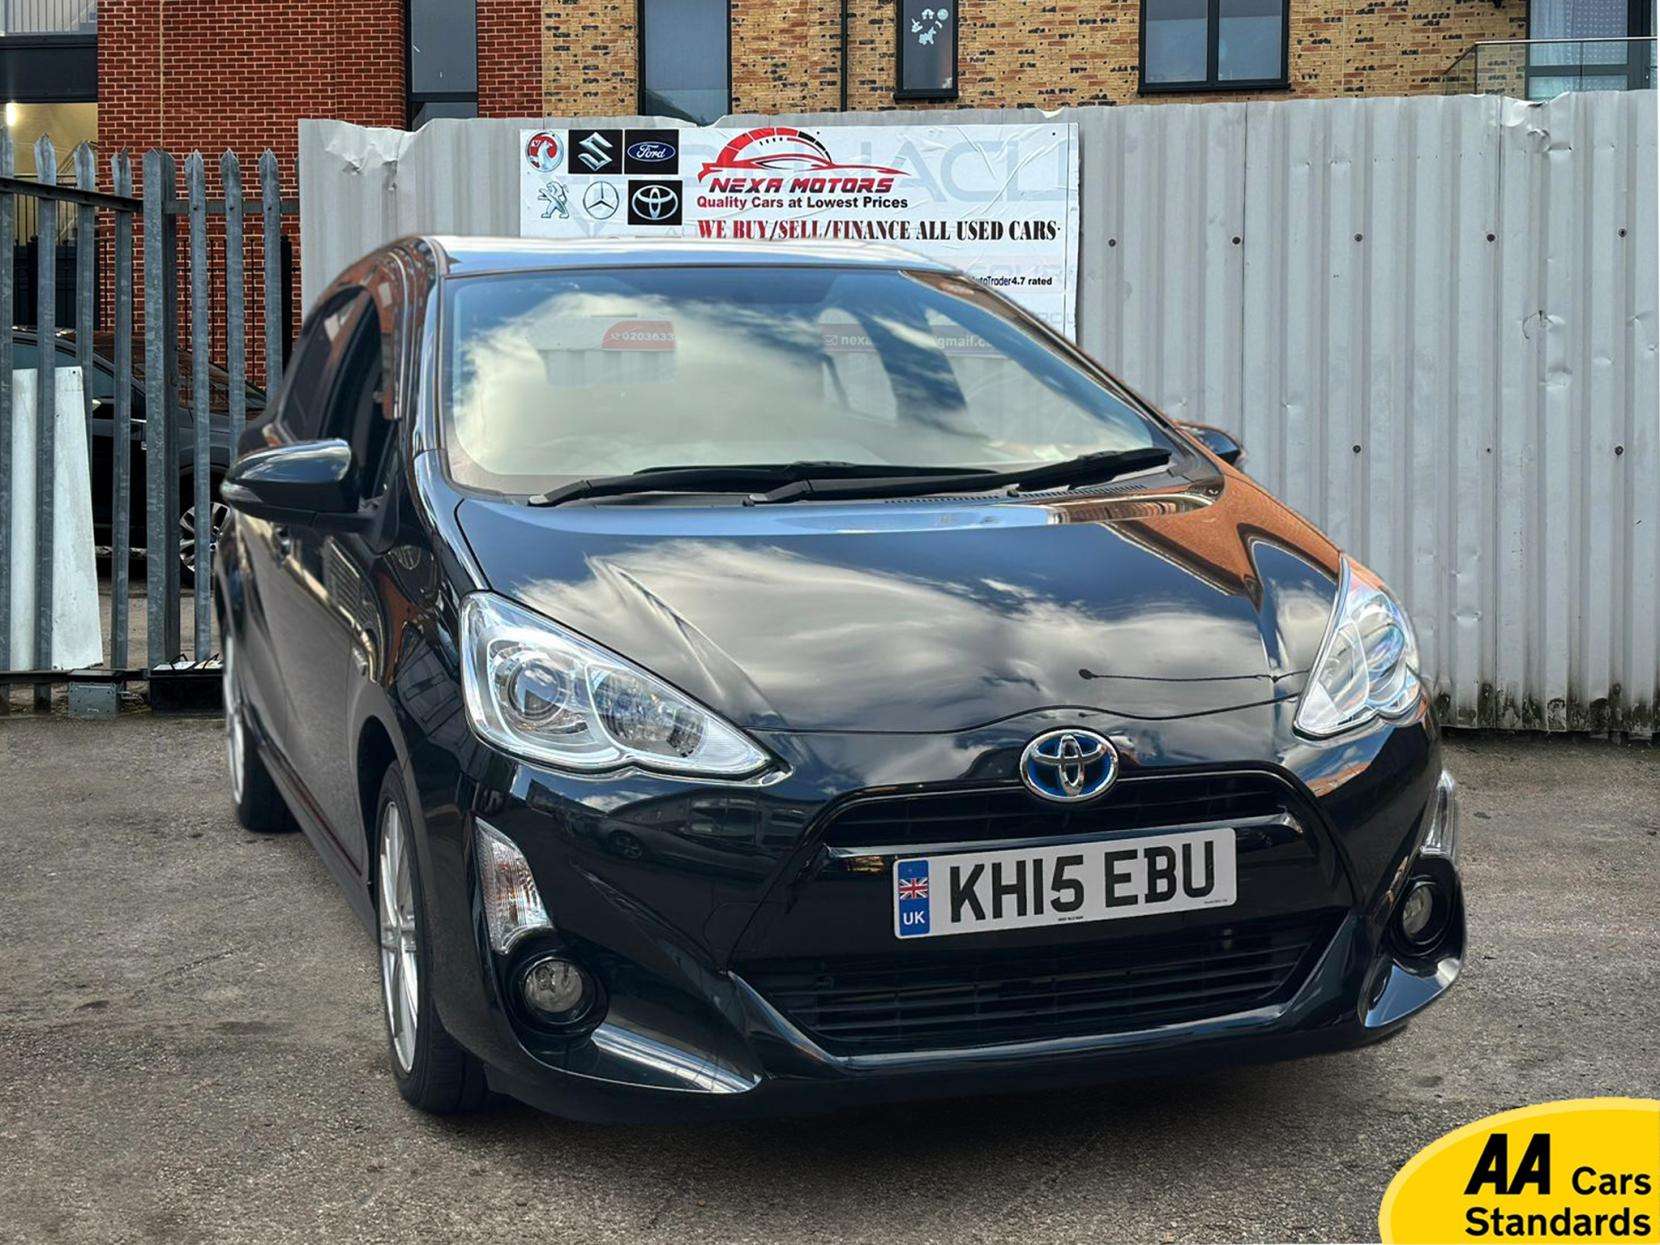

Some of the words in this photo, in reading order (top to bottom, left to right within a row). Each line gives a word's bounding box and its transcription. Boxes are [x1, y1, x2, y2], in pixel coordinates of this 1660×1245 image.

[636, 143, 666, 159] Ford
[708, 177, 784, 194] NEXA
[789, 177, 894, 194] MOTORS
[697, 196, 748, 211] Quality
[751, 197, 785, 209] Cars
[788, 197, 803, 209] at
[807, 197, 858, 209] Lowest
[863, 197, 909, 209] Prices
[697, 219, 726, 240] WE
[916, 220, 951, 241] ALL
[956, 220, 1004, 241] USED
[1008, 220, 1057, 241] CARS
[1027, 276, 1053, 286] rated
[949, 854, 1085, 924] KH15
[1104, 840, 1215, 909] EBU
[903, 910, 925, 926] UK
